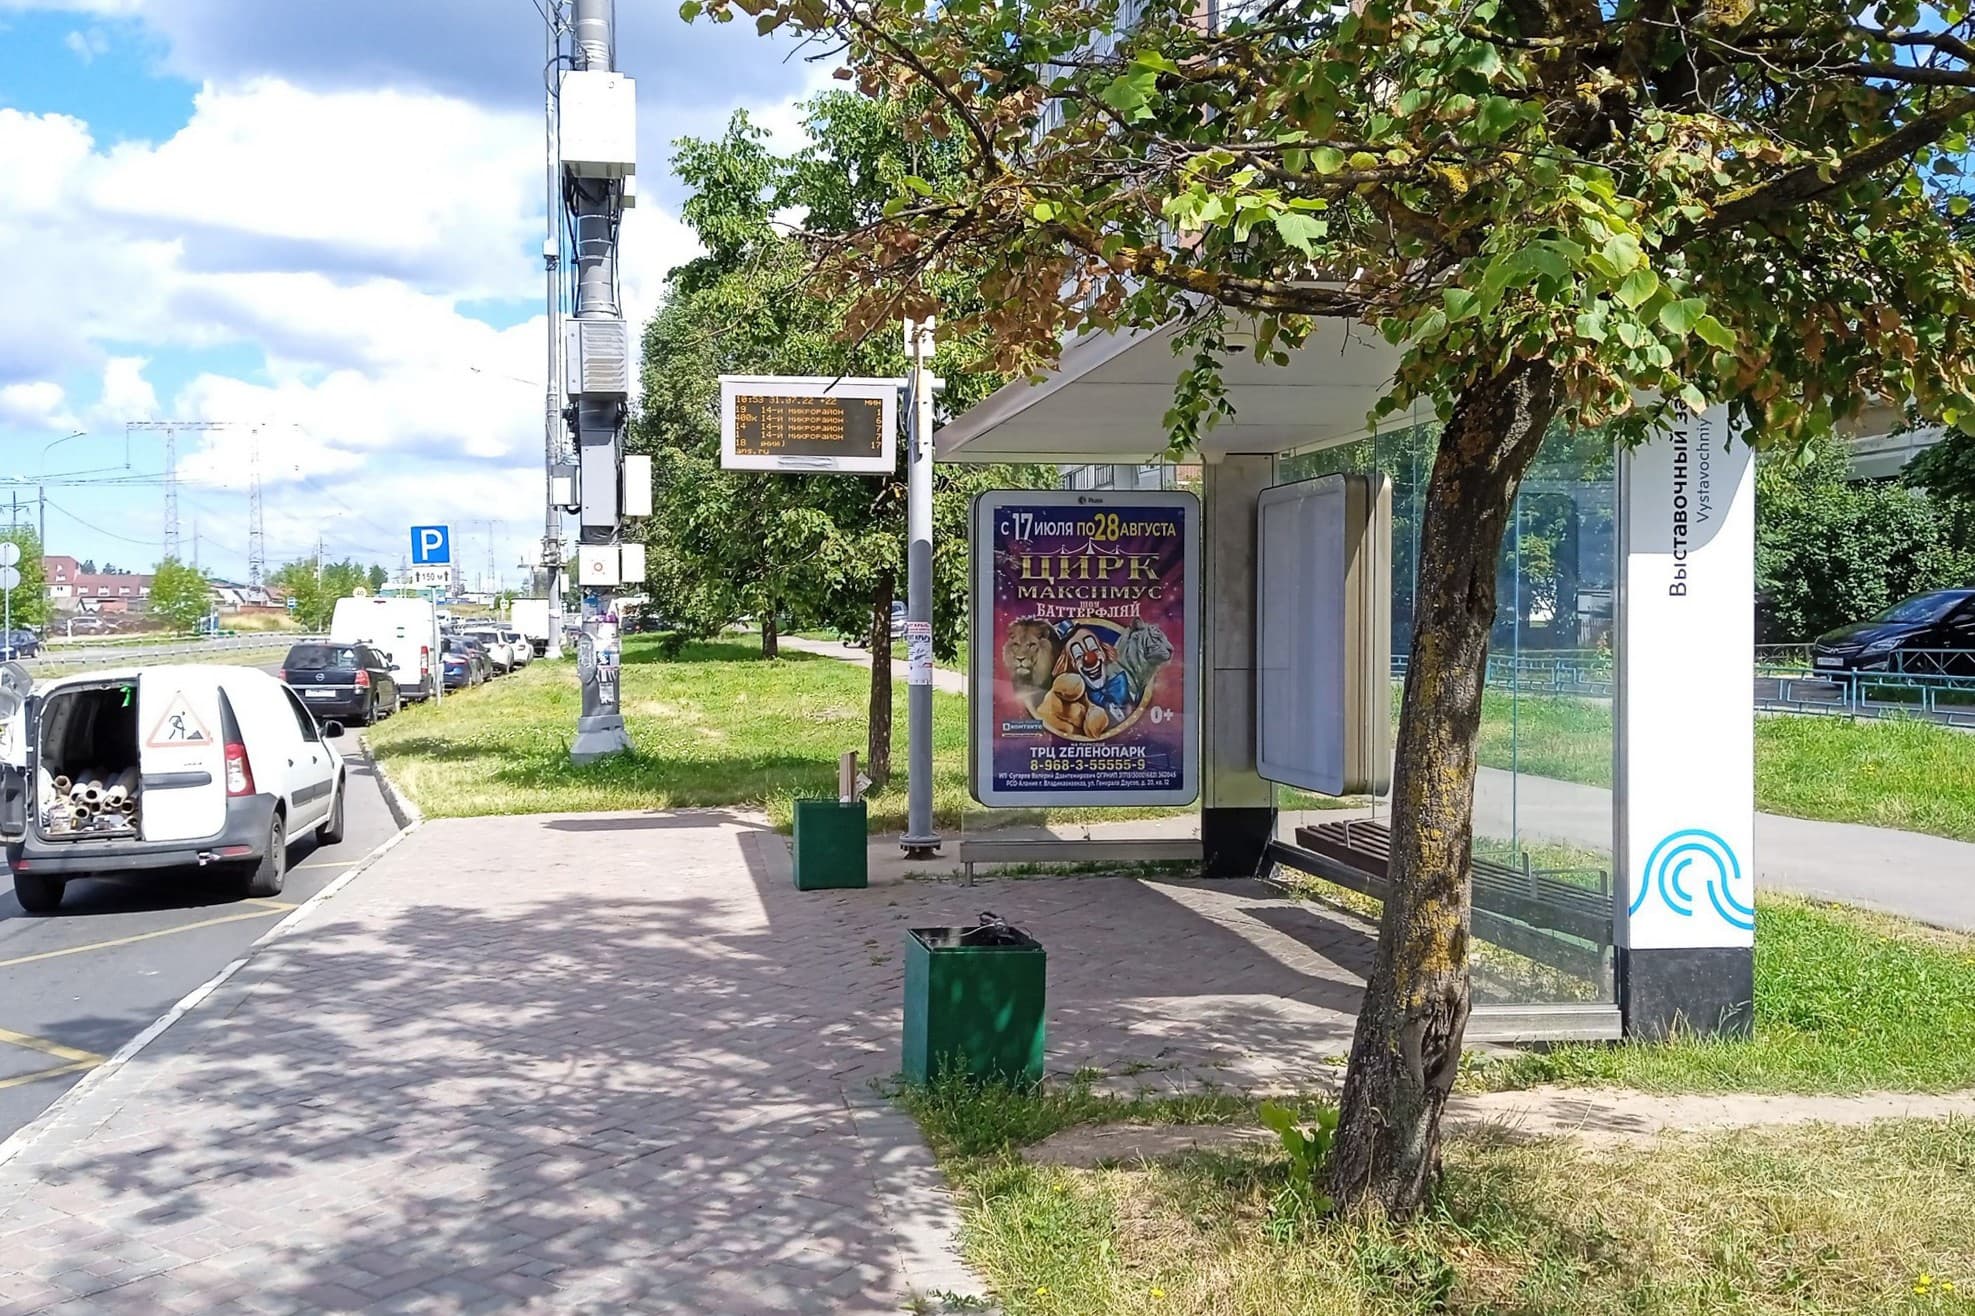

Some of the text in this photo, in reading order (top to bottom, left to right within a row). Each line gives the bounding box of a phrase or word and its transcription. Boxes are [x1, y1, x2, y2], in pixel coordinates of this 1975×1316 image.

[1696, 417, 1712, 523] Vystavochniy
[1669, 397, 1688, 597] Выставочный за
[1012, 512, 1034, 541] 17
[1034, 521, 1073, 536] ИЮЛЯ
[1076, 521, 1096, 536] ПО
[1094, 513, 1119, 541] 28
[1119, 522, 1176, 537] АВГУСТА
[422, 572, 435, 581] 150
[1019, 554, 1161, 585] ЦИРК
[1035, 602, 1141, 617] БАТТЕРФЛЯЙ
[1150, 705, 1174, 724] 0+
[1029, 746, 1056, 759] ТРЦ
[1030, 758, 1146, 771] 8-968-3-55555-9
